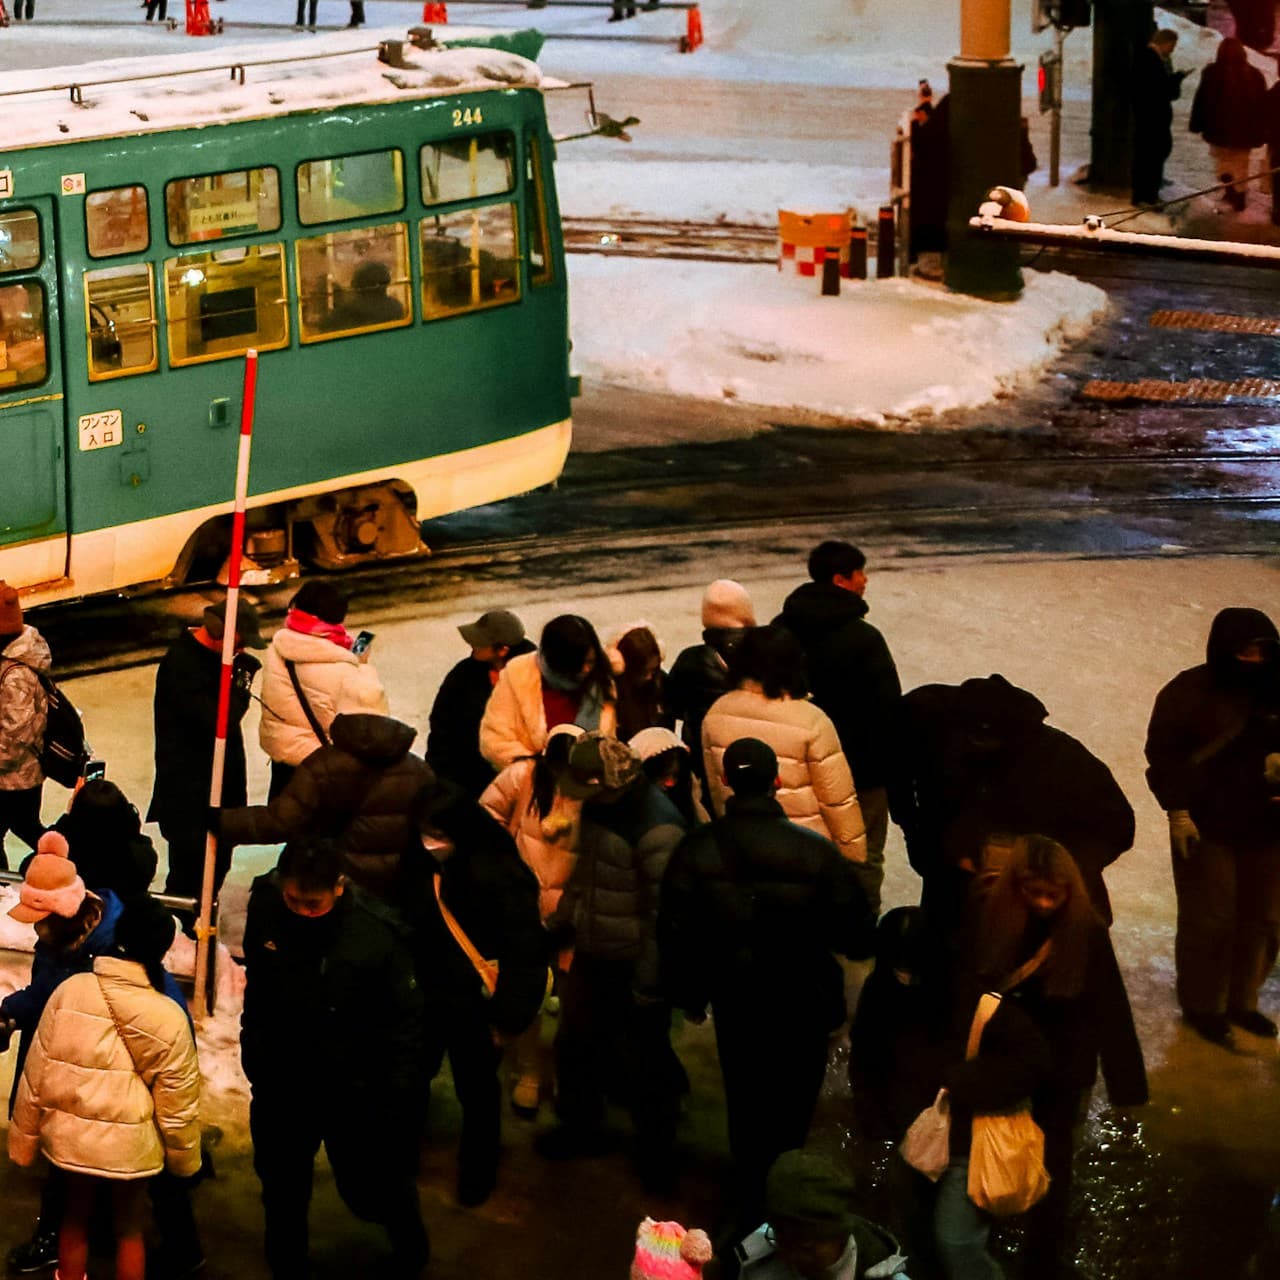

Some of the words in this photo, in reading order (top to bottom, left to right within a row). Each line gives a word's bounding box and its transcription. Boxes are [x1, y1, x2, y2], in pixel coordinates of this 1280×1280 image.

[452, 107, 483, 127] 244
[80, 414, 120, 430] ワンマン
[88, 431, 114, 446] 入口
